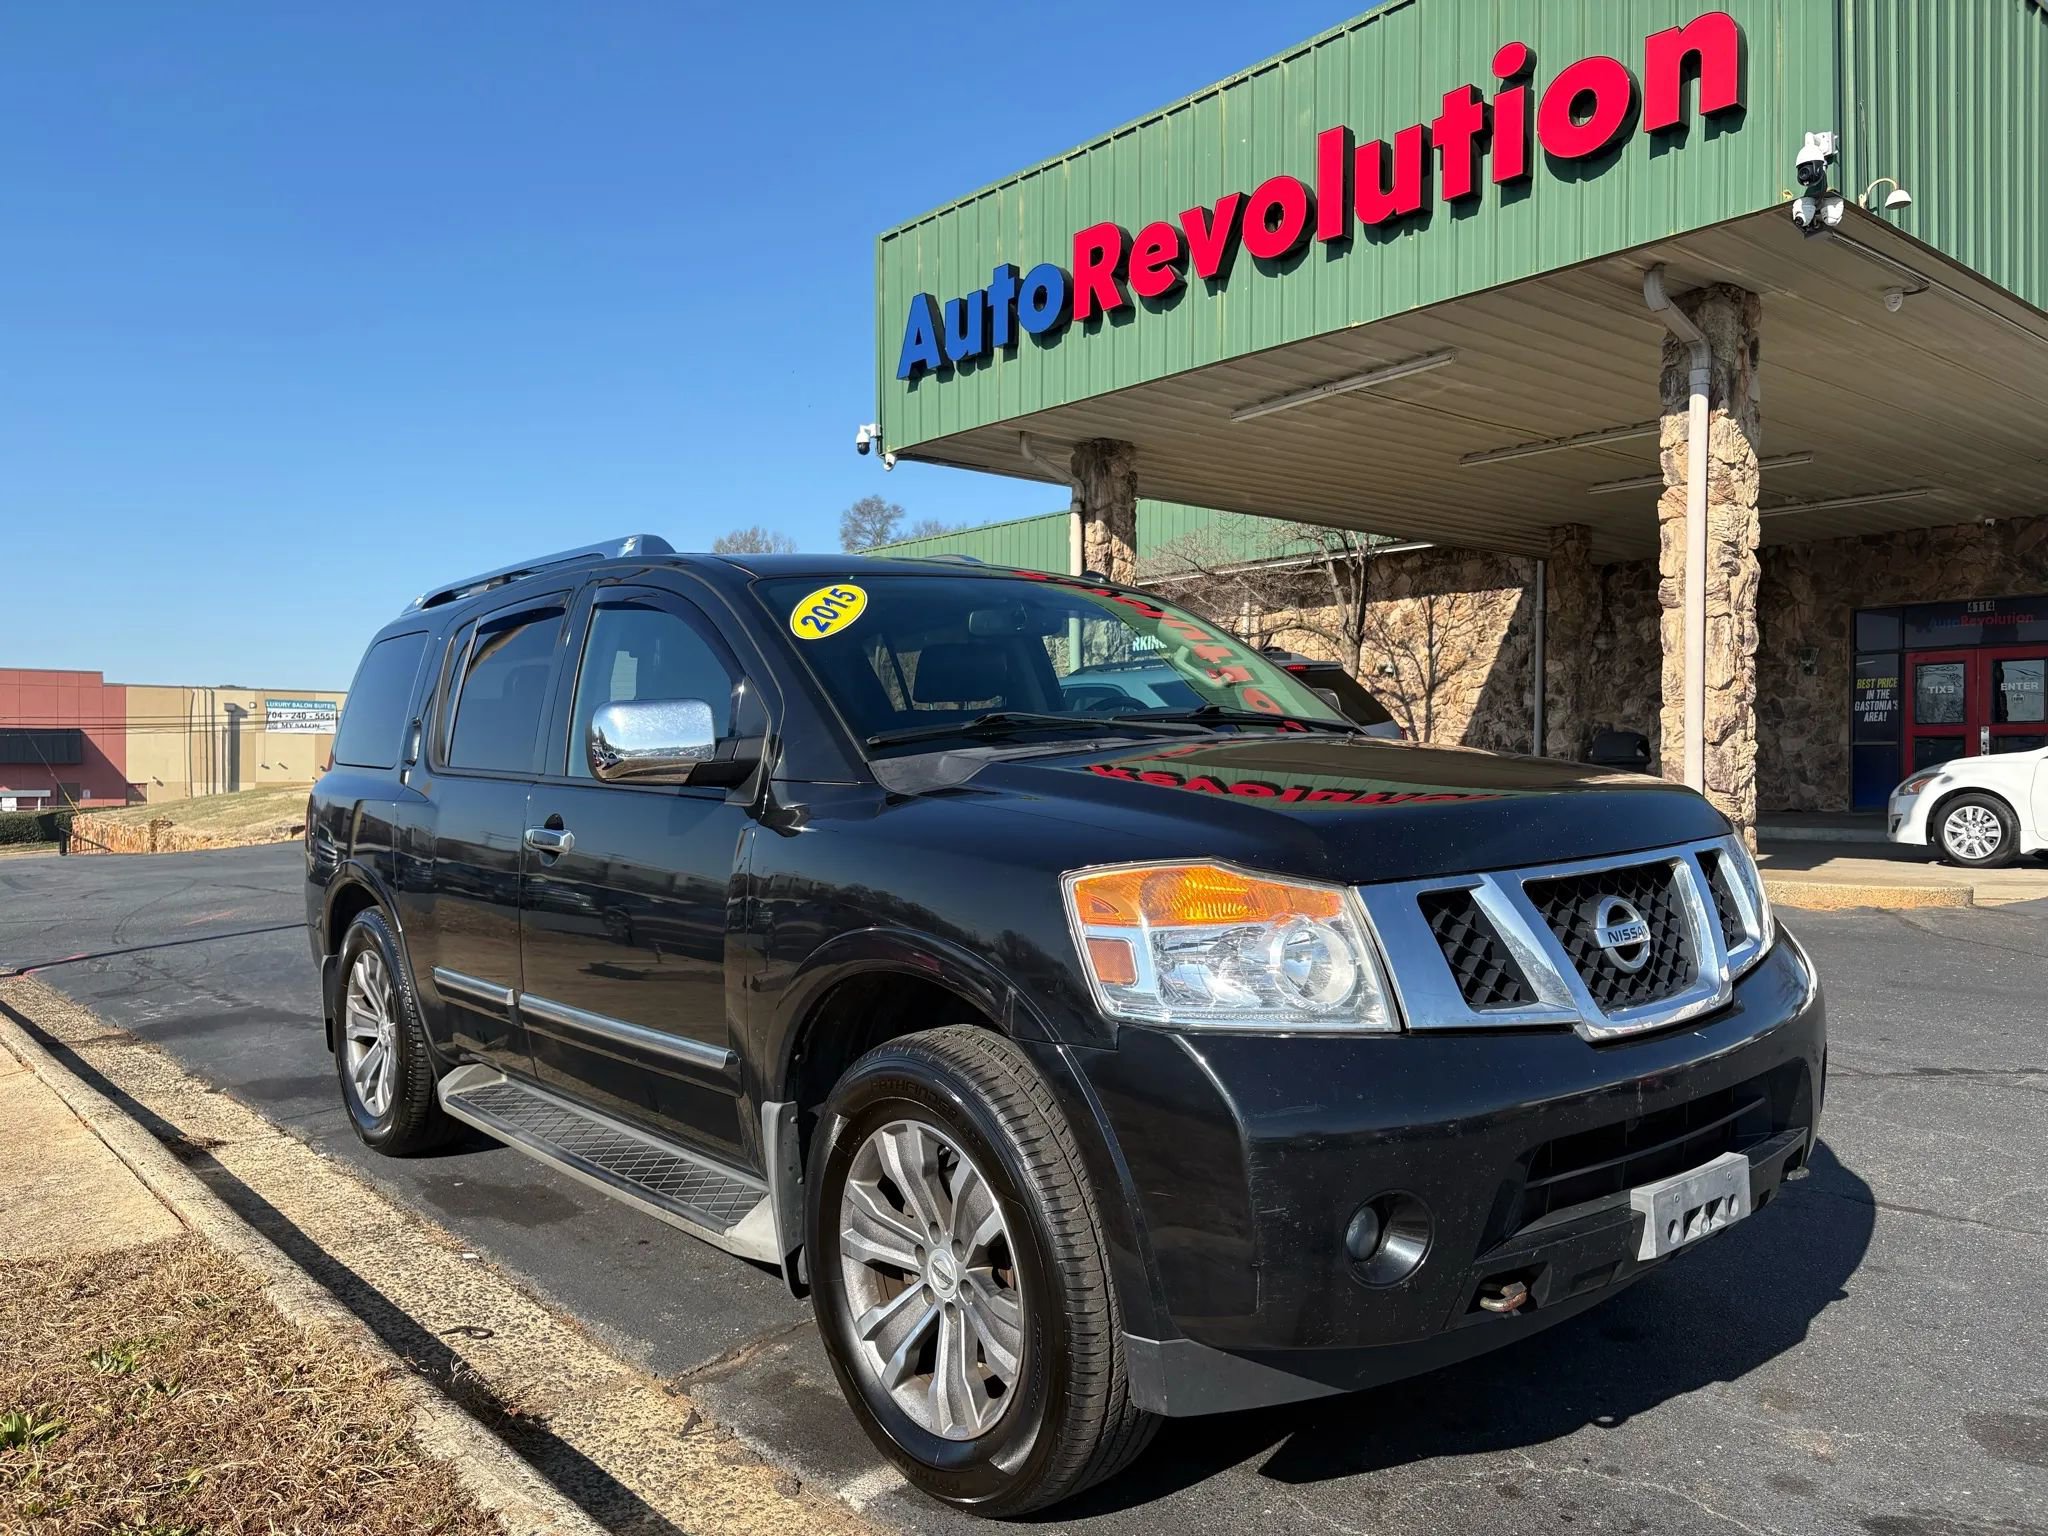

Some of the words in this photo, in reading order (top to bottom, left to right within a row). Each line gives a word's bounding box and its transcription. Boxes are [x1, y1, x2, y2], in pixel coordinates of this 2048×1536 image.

[896, 11, 1746, 382] AutoRevolution
[801, 588, 857, 633] 2015
[1856, 678, 1876, 689] BEST
[1877, 677, 1898, 688] PRICE
[2000, 681, 2040, 691] ENTER
[1866, 689, 1875, 700] IN
[1876, 689, 1890, 699] THE
[1855, 700, 1899, 711] GASTONIA'S
[1864, 711, 1888, 722] AREA!
[1607, 924, 1648, 943] NISSAN
